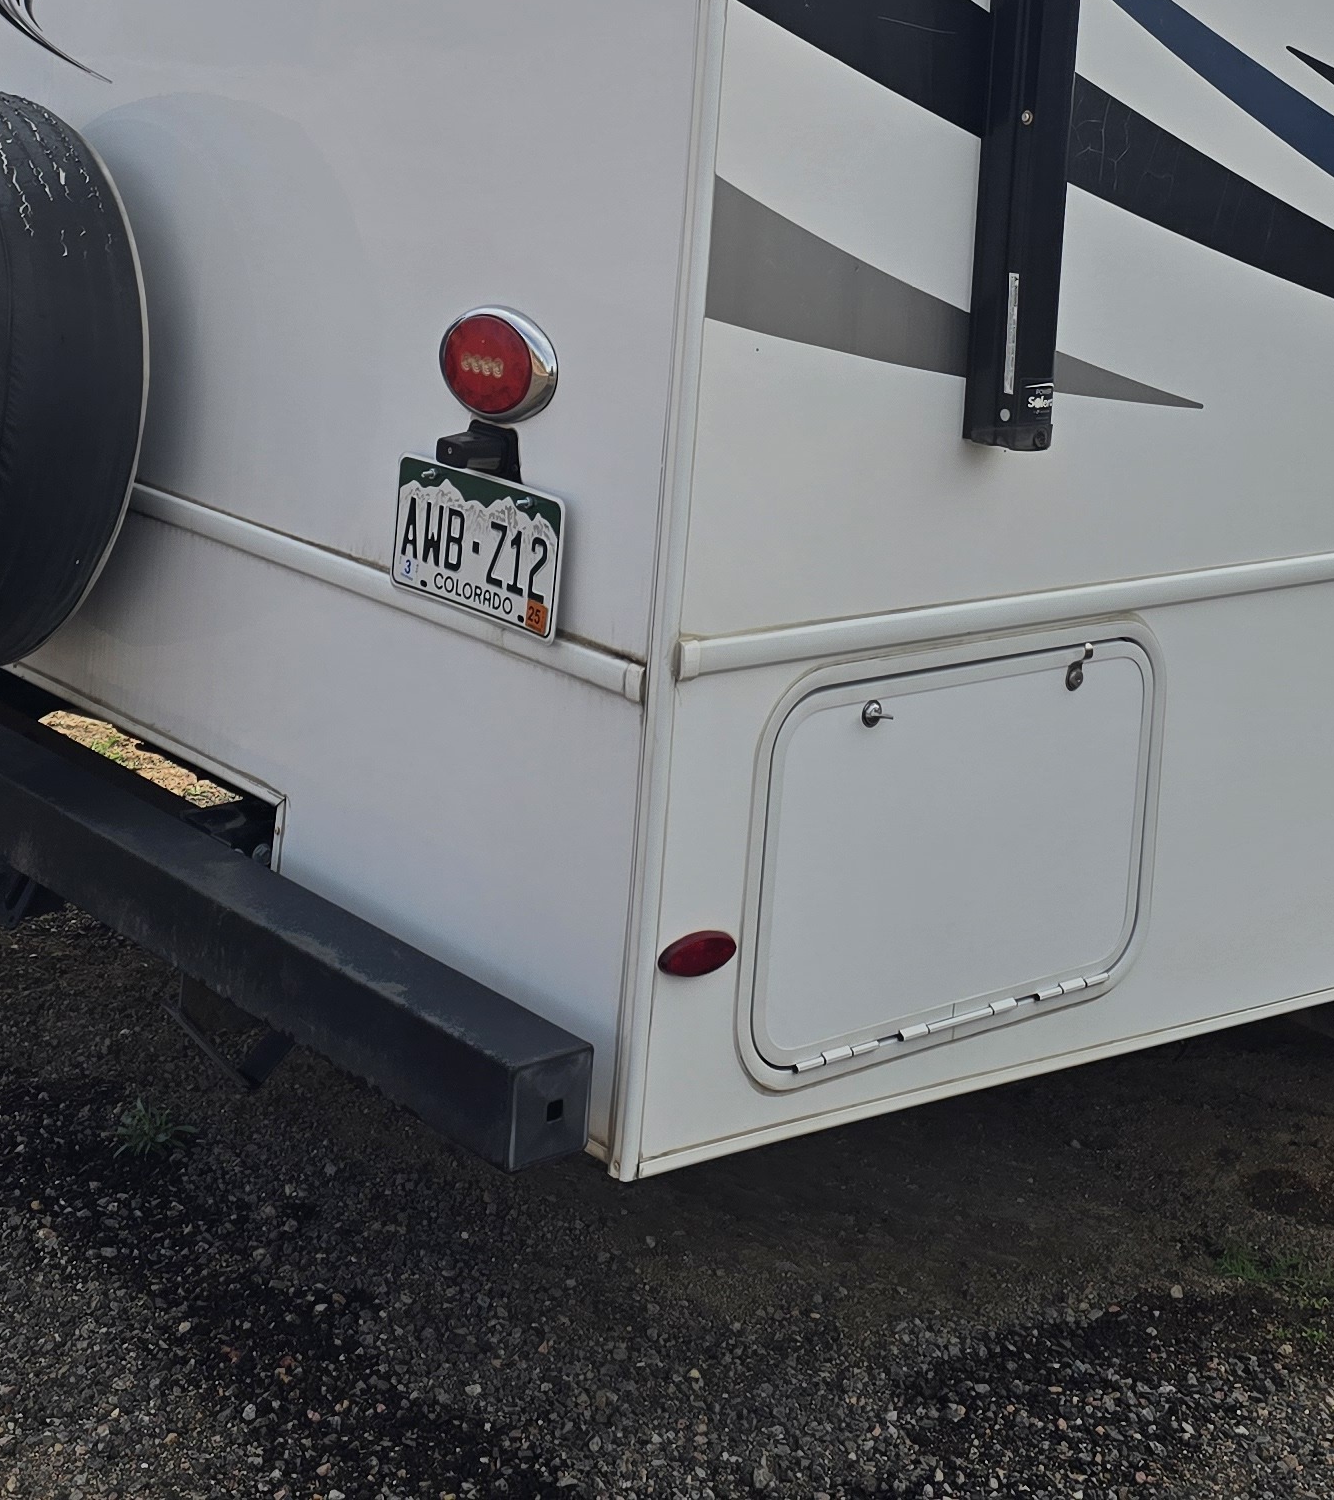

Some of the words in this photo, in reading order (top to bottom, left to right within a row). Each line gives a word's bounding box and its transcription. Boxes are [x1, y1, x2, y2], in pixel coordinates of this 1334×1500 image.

[404, 559, 412, 574] 3
[433, 572, 513, 615] COLORADO
[527, 605, 541, 625] 25
